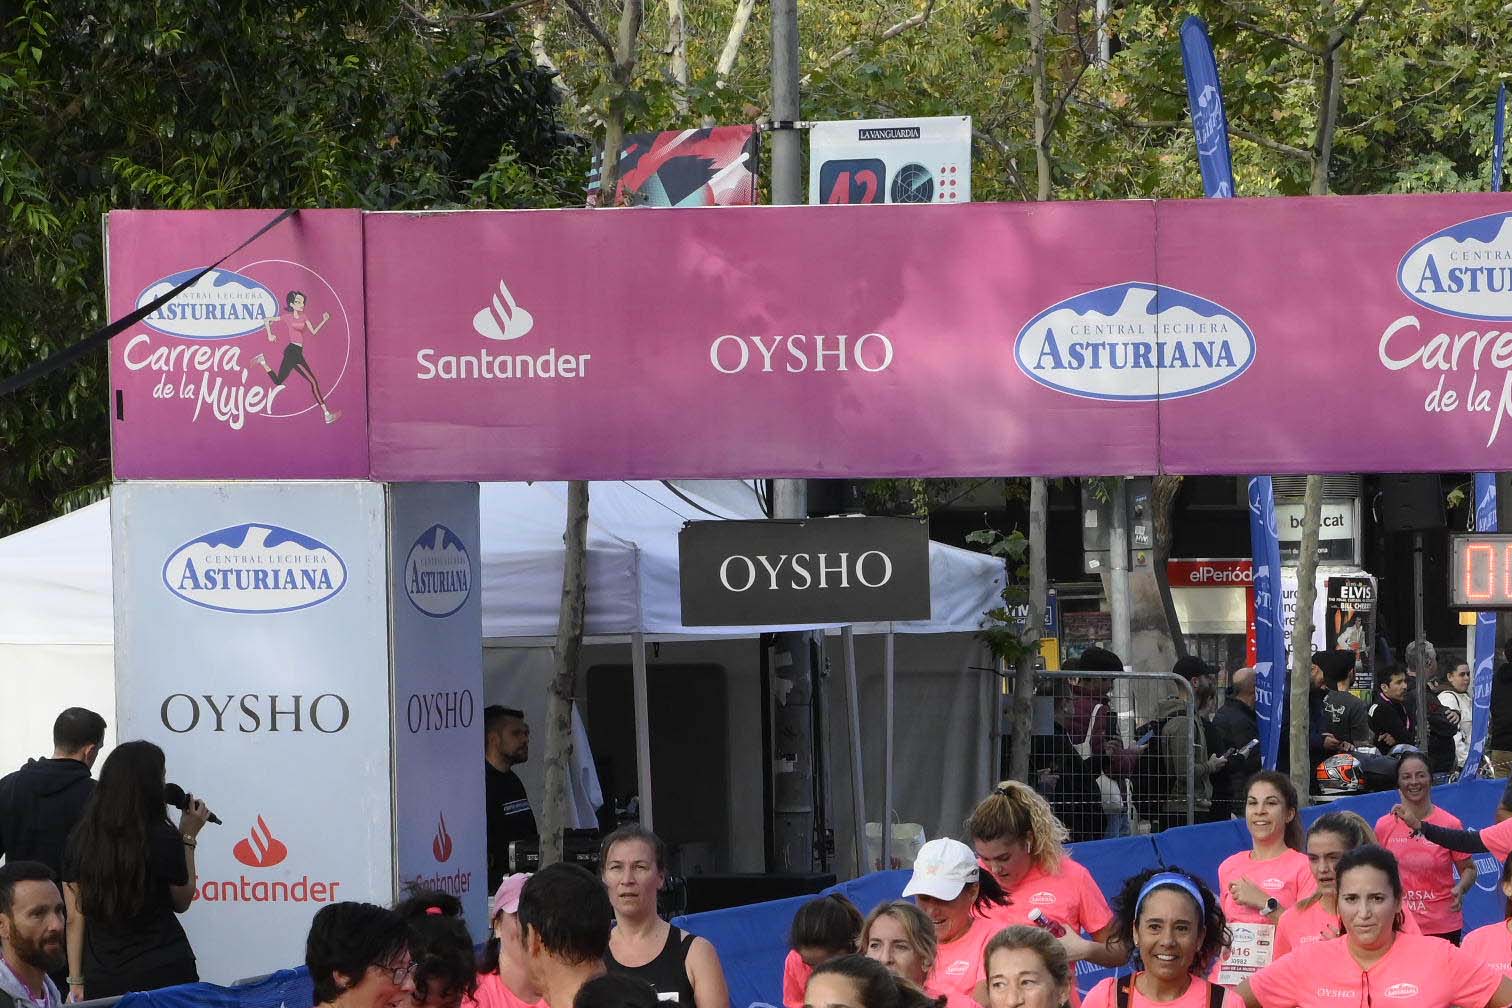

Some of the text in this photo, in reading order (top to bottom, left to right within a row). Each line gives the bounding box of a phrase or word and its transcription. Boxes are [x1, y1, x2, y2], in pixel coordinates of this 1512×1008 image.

[869, 129, 919, 139] VANGUARDIA
[147, 294, 267, 320] ASTURIANA
[174, 290, 263, 300] ENTRAL LECHERA
[1070, 321, 1229, 335] CENTRAL LECHERA
[123, 334, 241, 371] Carrera
[416, 347, 591, 380] Santander
[709, 333, 893, 374] OYSHO
[1033, 328, 1238, 371] ASTURIANA
[152, 367, 287, 430] de la Mujer
[1425, 373, 1459, 414] de
[1466, 373, 1491, 413] la
[177, 557, 334, 591] ASTURIANA
[205, 554, 328, 564] CENTRAL LECHERA
[409, 558, 468, 595] ASTURIANA
[719, 551, 893, 592] OYSHO
[1189, 566, 1252, 583] elPeriód
[1340, 586, 1372, 600] ELVIS
[160, 692, 350, 735] OYSHO
[406, 688, 475, 735] OYSHO
